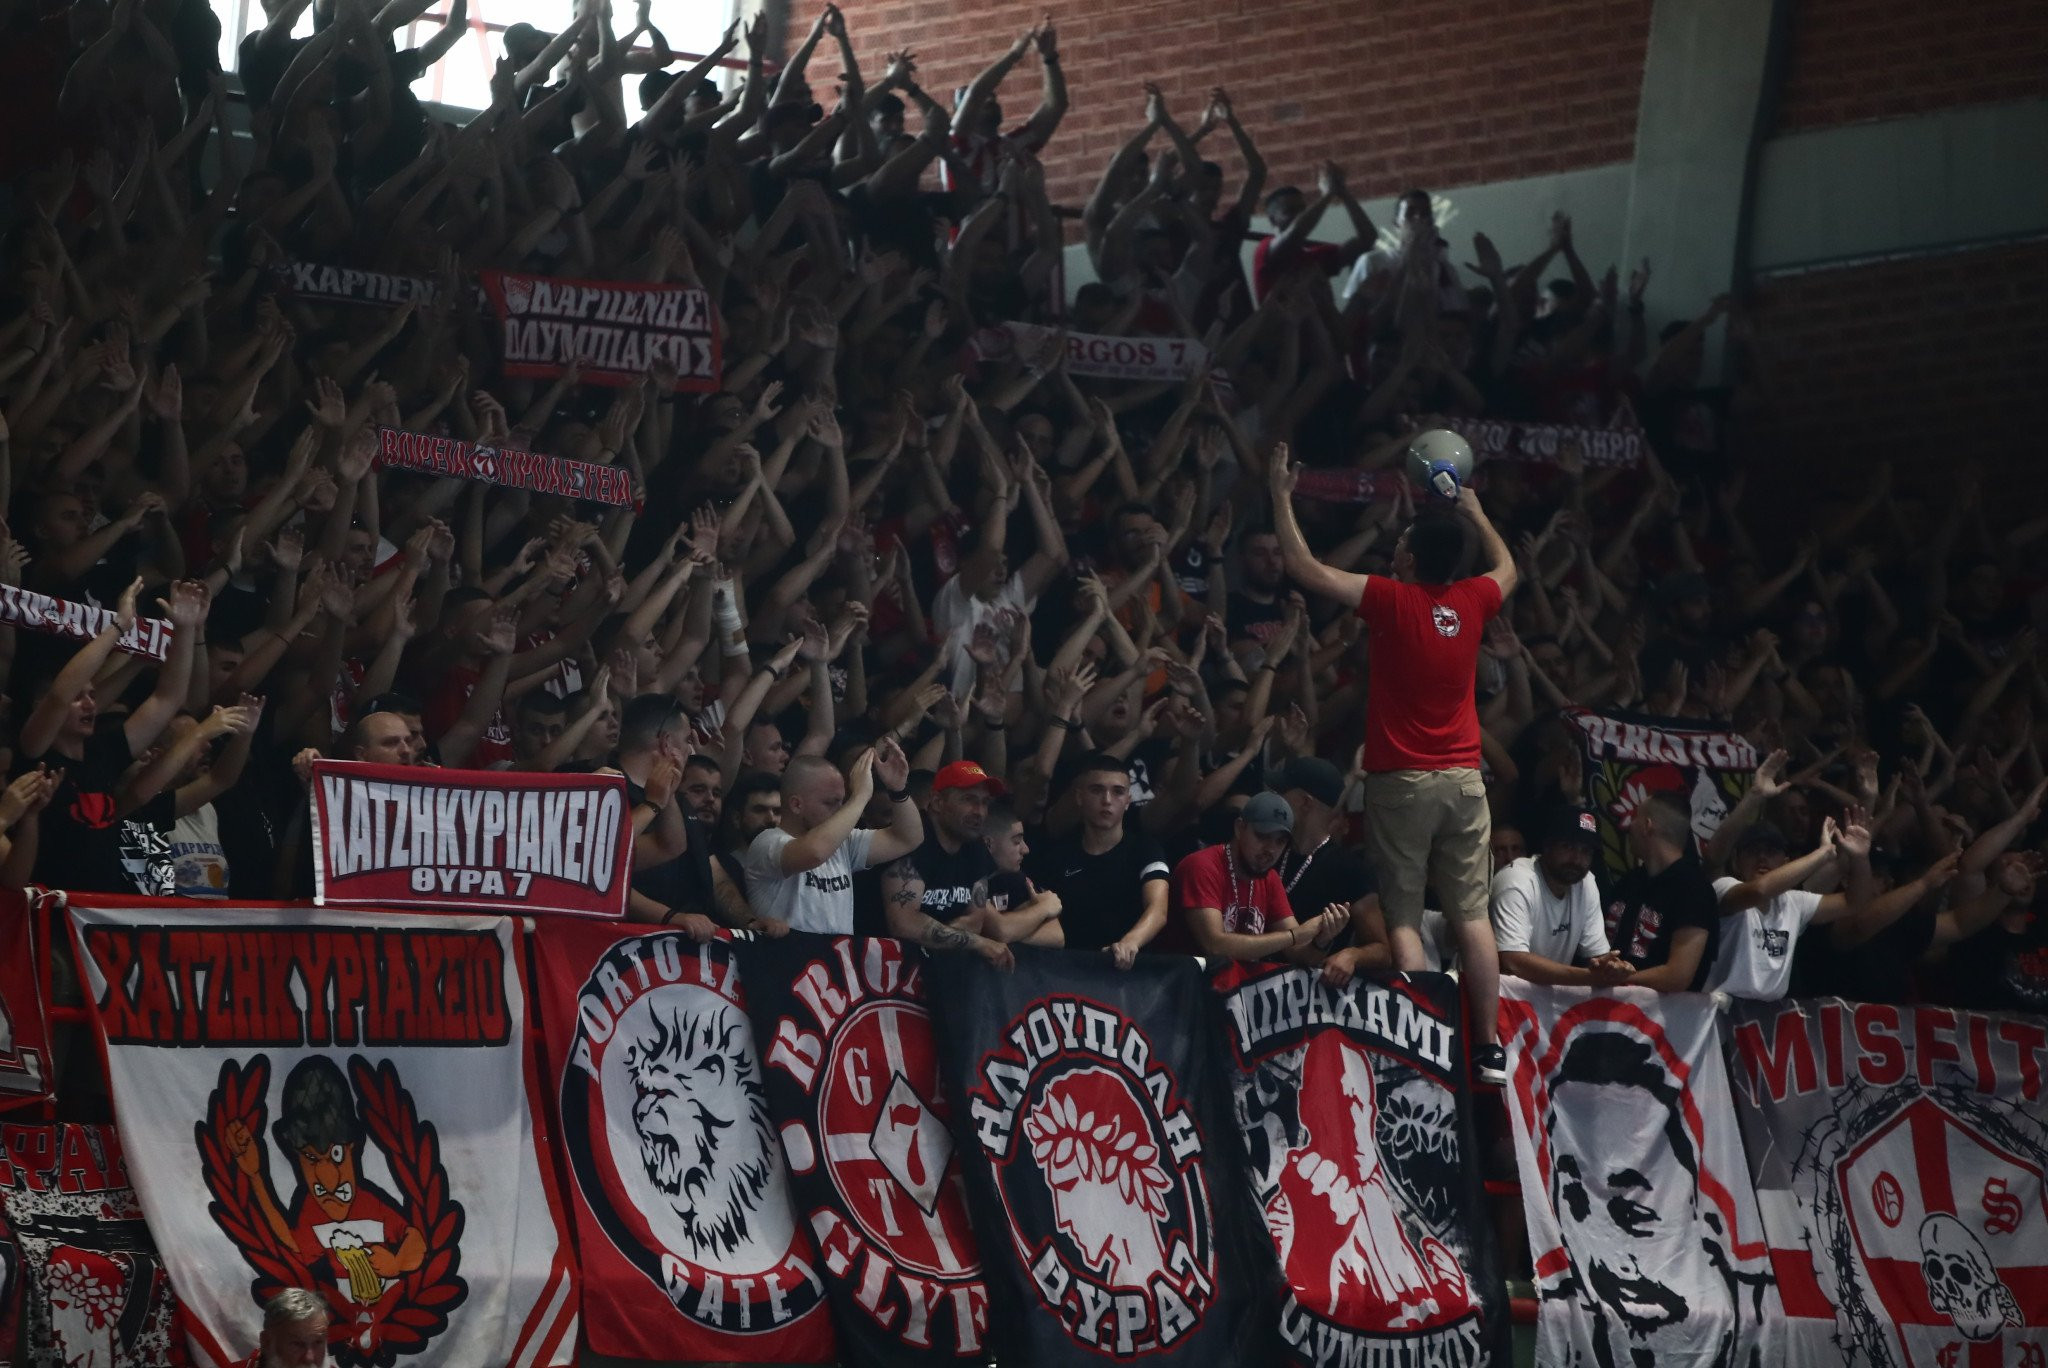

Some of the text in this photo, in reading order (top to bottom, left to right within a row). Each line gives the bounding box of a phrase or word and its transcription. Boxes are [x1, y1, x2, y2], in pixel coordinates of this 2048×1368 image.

[1170, 344, 1186, 367] 7
[322, 775, 621, 894] ΧΑΤΖΗΚΥΡΙΑΚΕΙΟ
[411, 867, 533, 898] ΘΥΡΑ 7
[88, 928, 510, 1047] ΧΑΤΖΗΚΥΡΙΑΚΕΙΟ
[571, 935, 681, 1085] PORTO
[889, 1103, 926, 1188] 7
[661, 1252, 793, 1330] GATE
